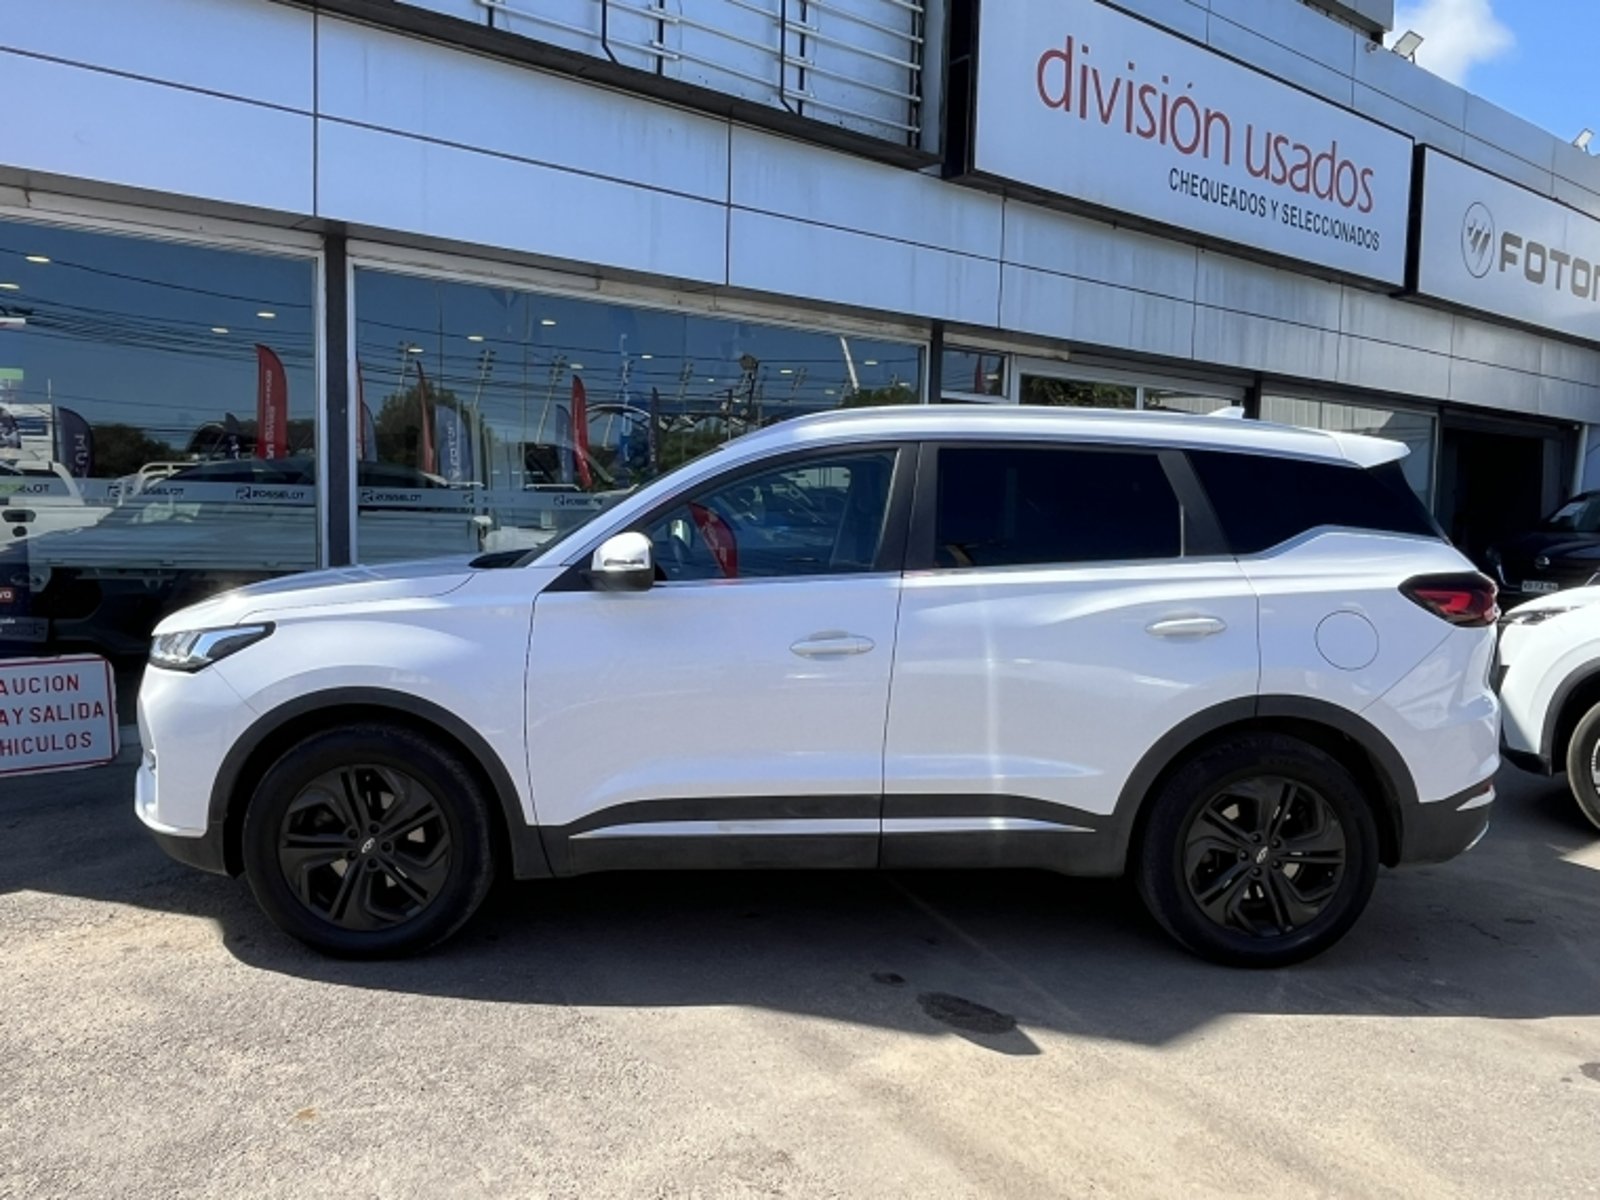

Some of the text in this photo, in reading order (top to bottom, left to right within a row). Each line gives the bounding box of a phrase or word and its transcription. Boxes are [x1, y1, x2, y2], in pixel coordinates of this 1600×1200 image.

[1037, 35, 1374, 213] división usados
[1168, 167, 1380, 251] CHEQUEADOS Y SELECCIONADOS
[29, 700, 104, 723] SALIDA
[0, 731, 92, 757] HICULOS
